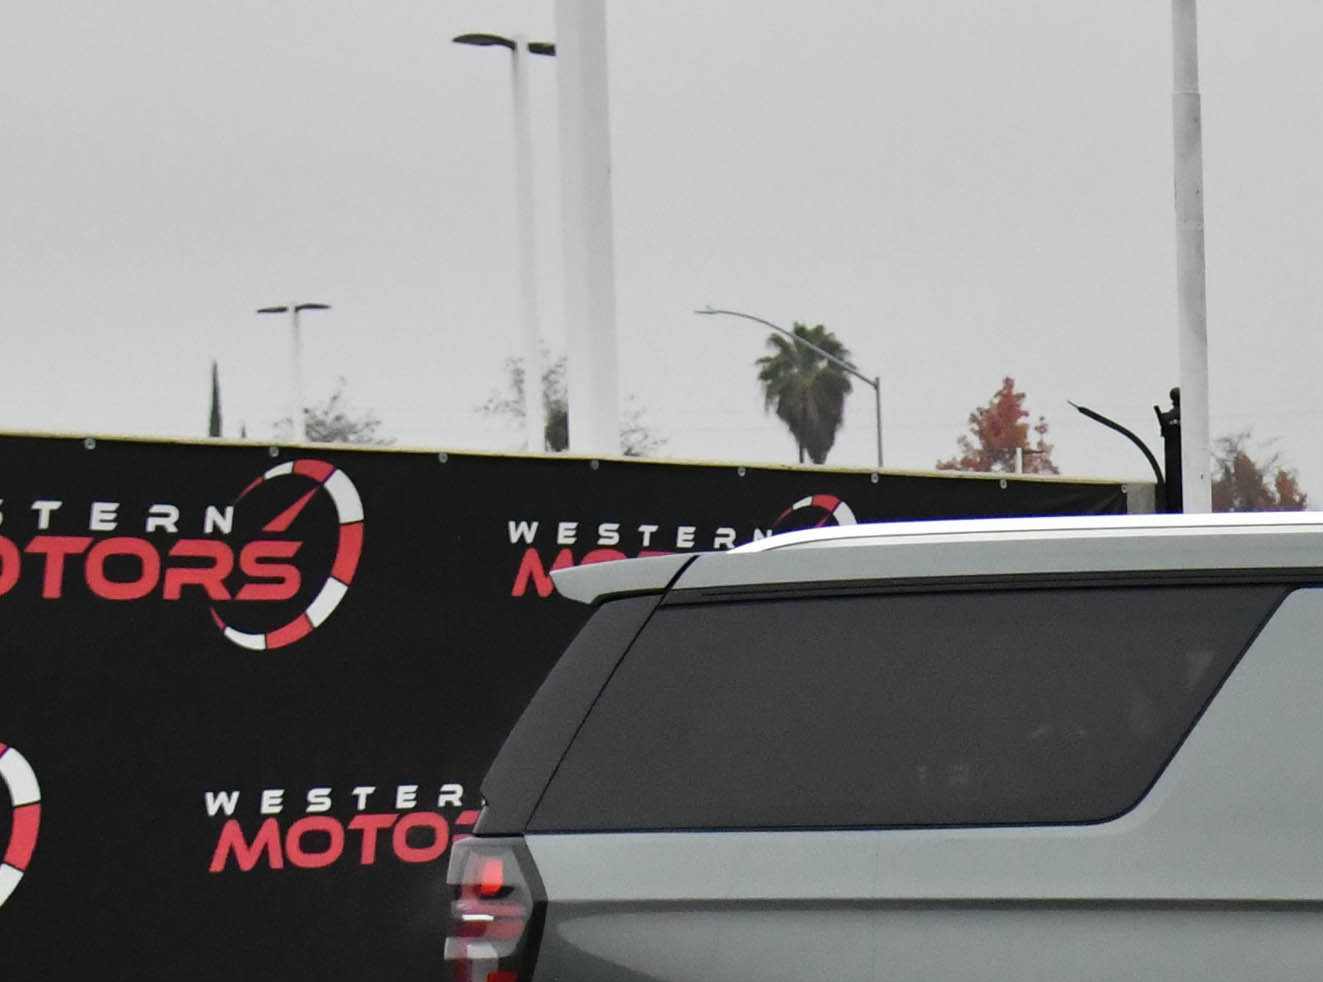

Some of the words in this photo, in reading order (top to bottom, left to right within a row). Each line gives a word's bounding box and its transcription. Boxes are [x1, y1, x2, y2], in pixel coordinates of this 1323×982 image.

[0, 498, 235, 534] TERN
[0, 533, 303, 600] TORS
[204, 783, 486, 817] WESTER
